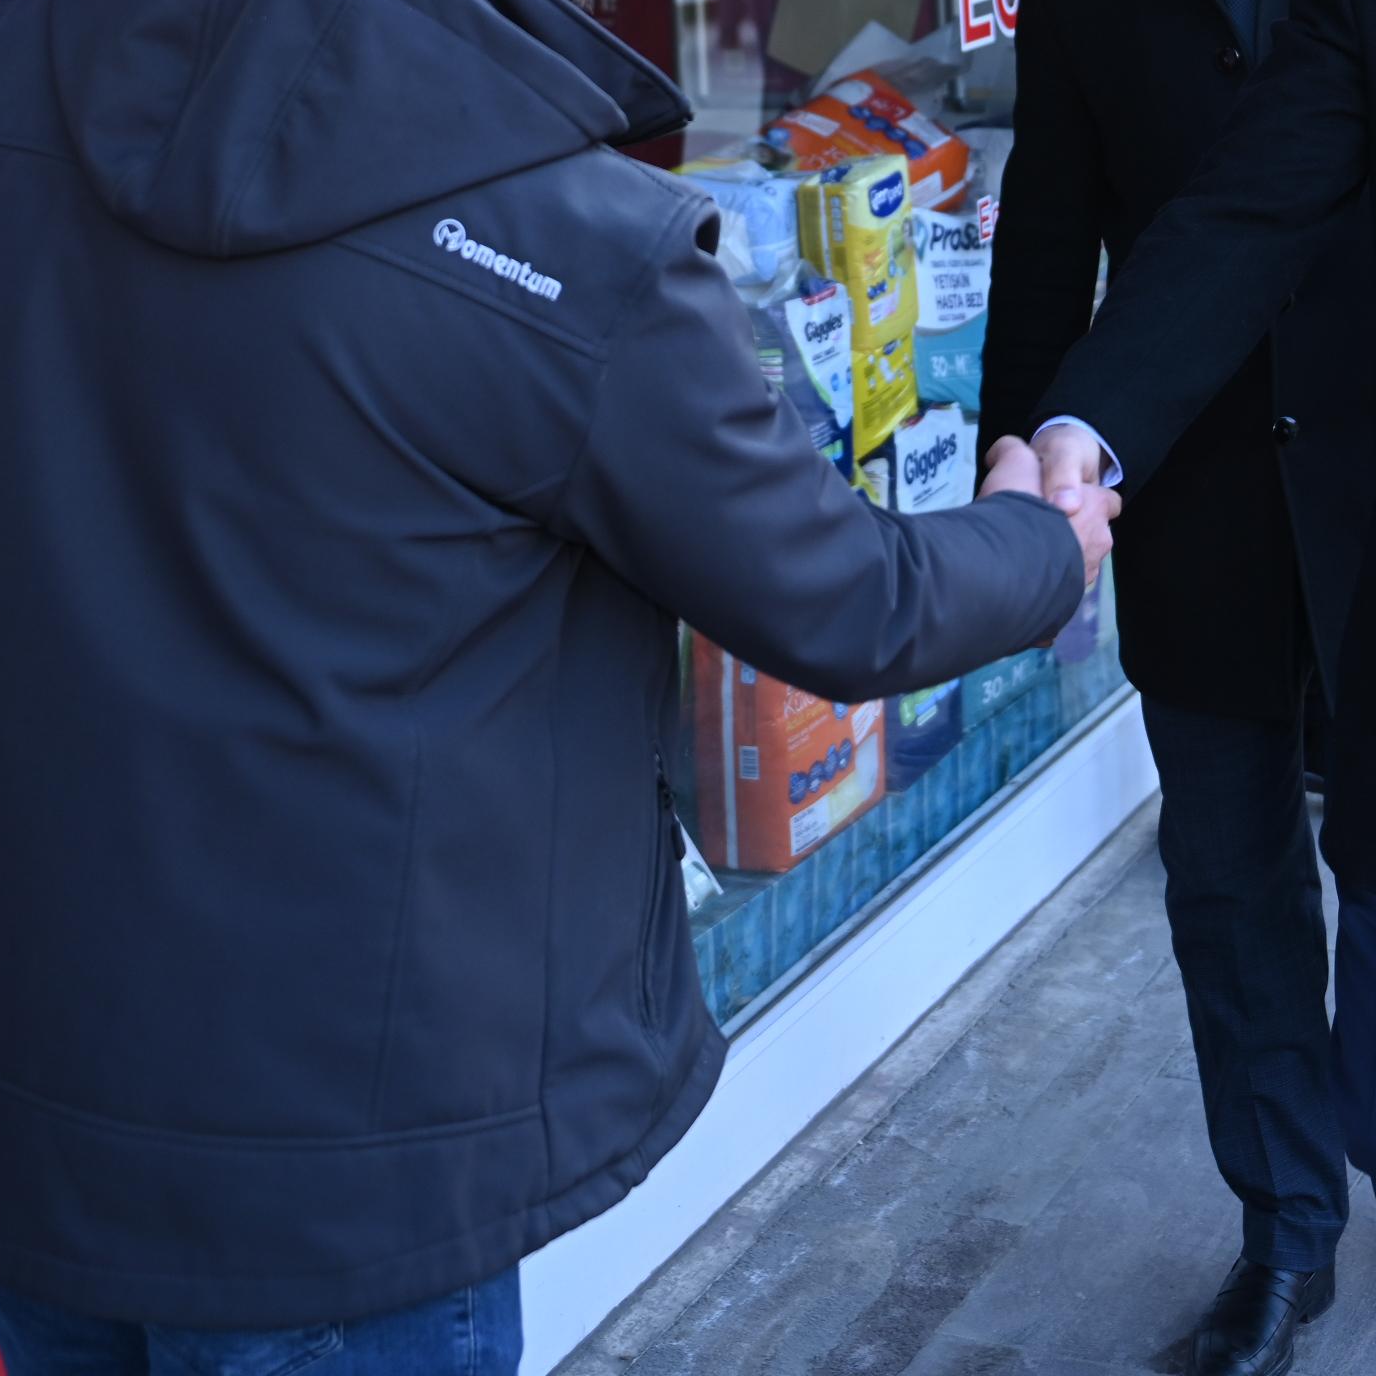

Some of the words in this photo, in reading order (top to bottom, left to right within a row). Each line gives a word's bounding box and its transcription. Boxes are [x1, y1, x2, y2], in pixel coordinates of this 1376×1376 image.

[433, 218, 562, 302] Momentum
[935, 293, 964, 311] HASTA
[804, 313, 843, 344] Giggles
[903, 433, 957, 485] Giggles
